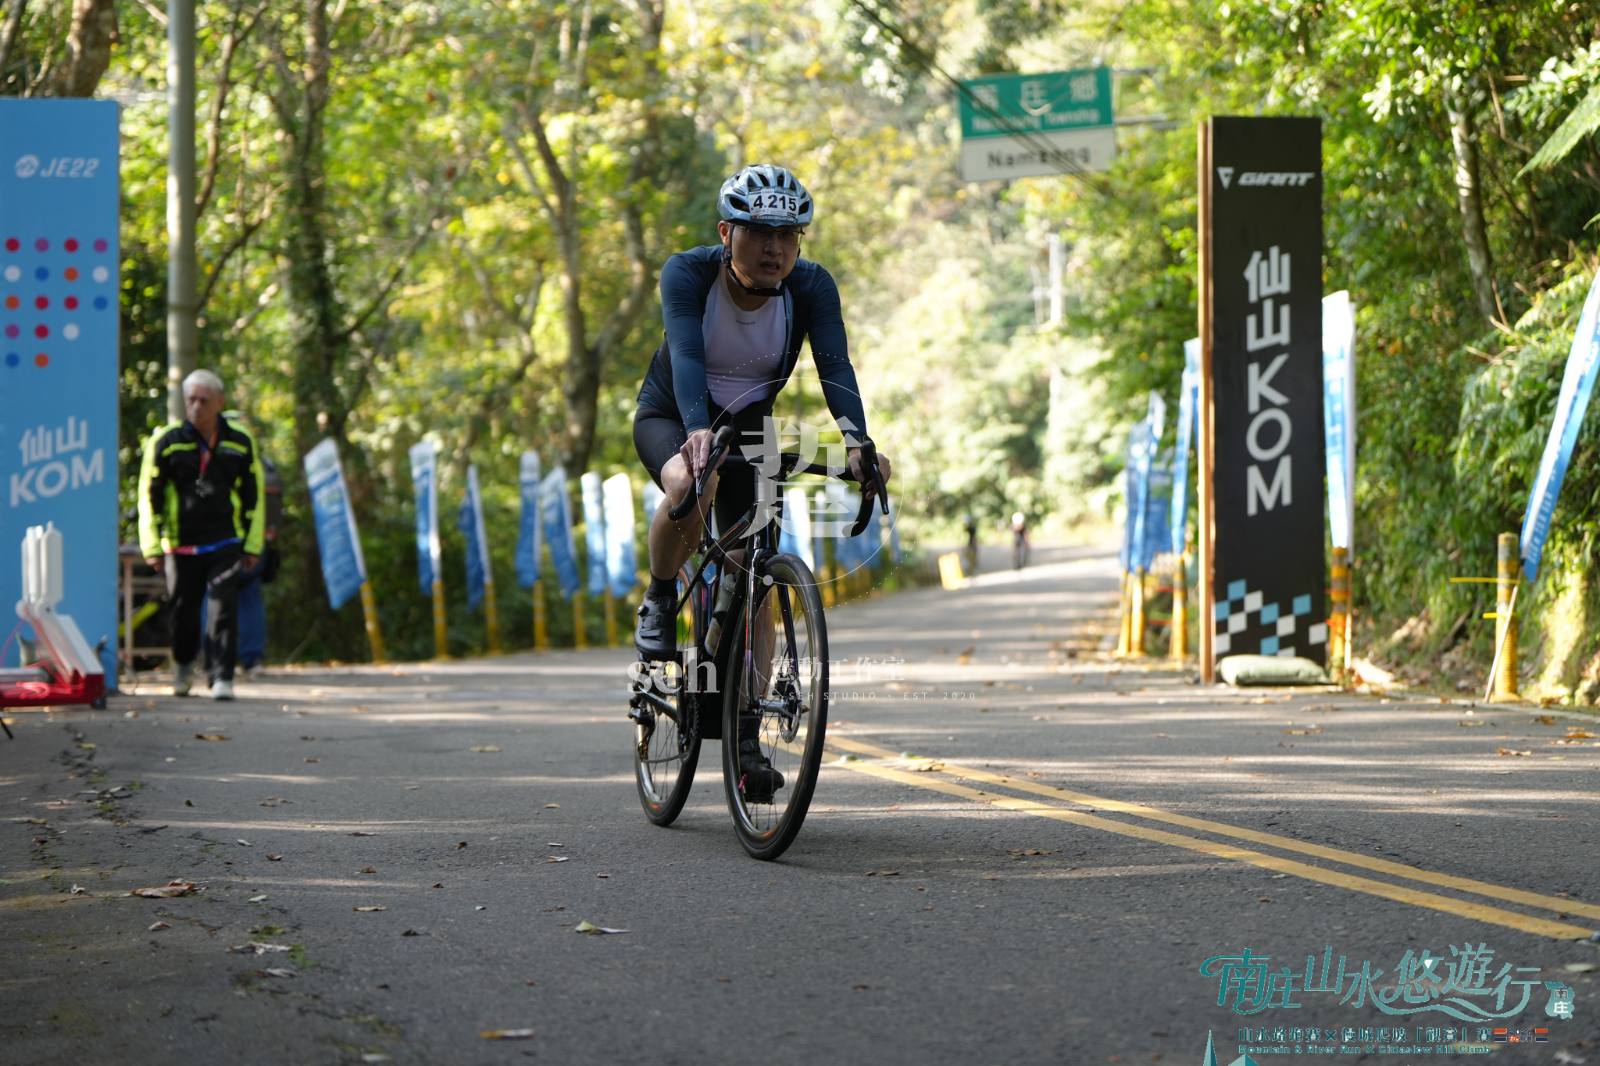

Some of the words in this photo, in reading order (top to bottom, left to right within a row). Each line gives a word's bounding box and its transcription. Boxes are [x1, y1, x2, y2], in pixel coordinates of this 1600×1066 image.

[1238, 171, 1315, 187] GIANT
[19, 415, 89, 468] 仙山
[9, 448, 104, 508] KOM
